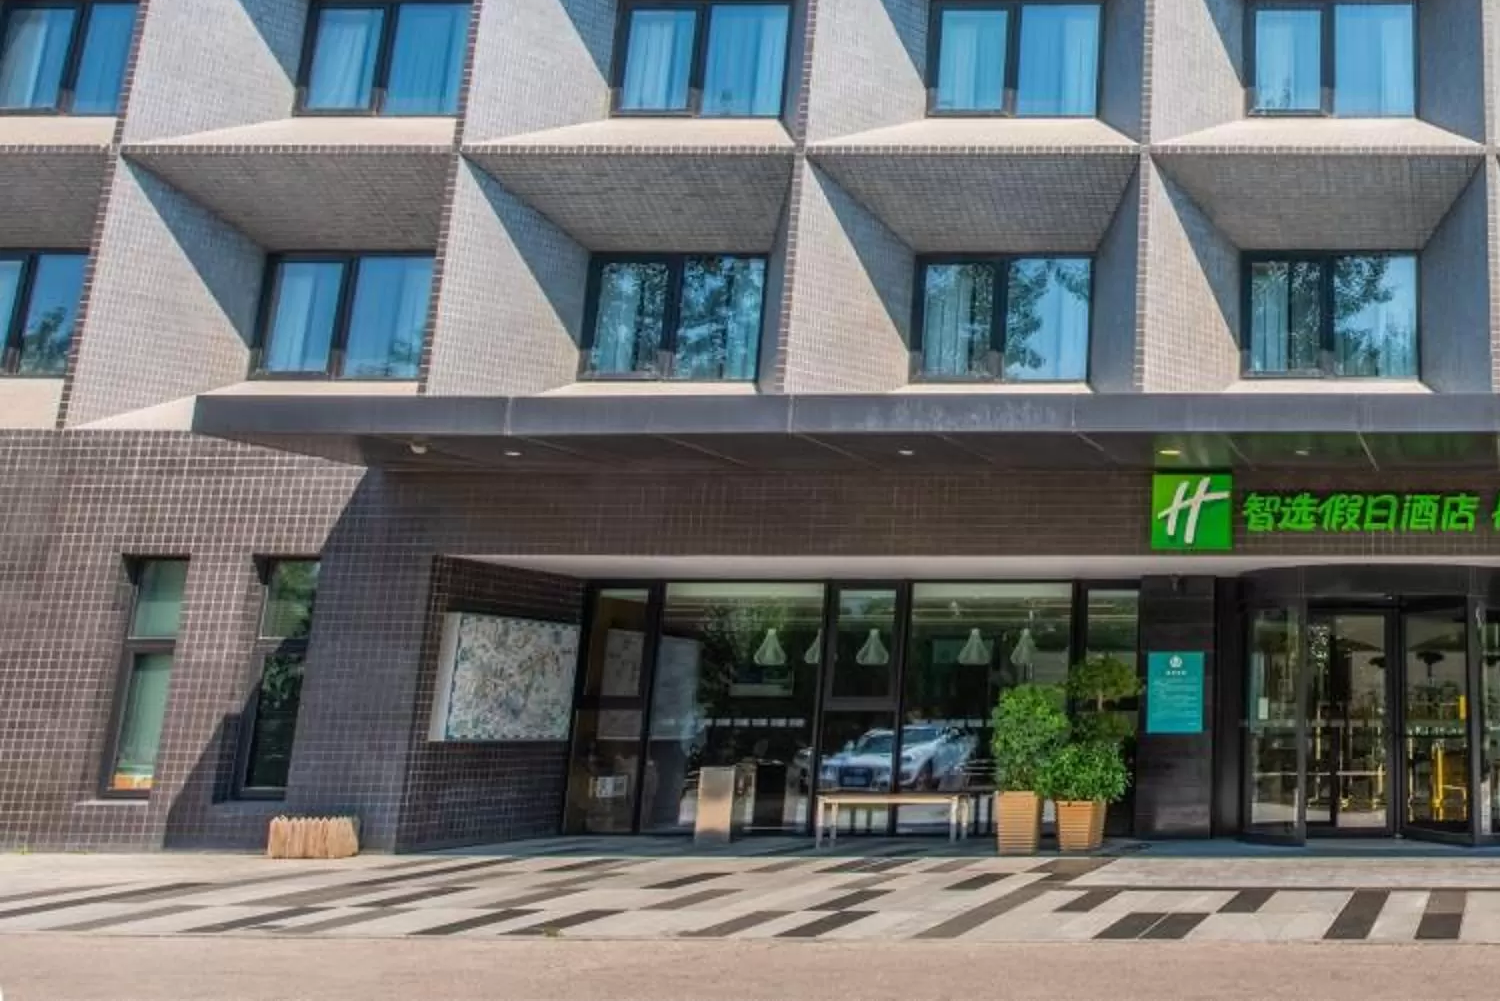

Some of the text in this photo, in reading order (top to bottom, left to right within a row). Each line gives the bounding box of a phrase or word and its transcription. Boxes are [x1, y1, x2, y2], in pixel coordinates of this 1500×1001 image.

[1243, 492, 1481, 533] 智选假日酒店
